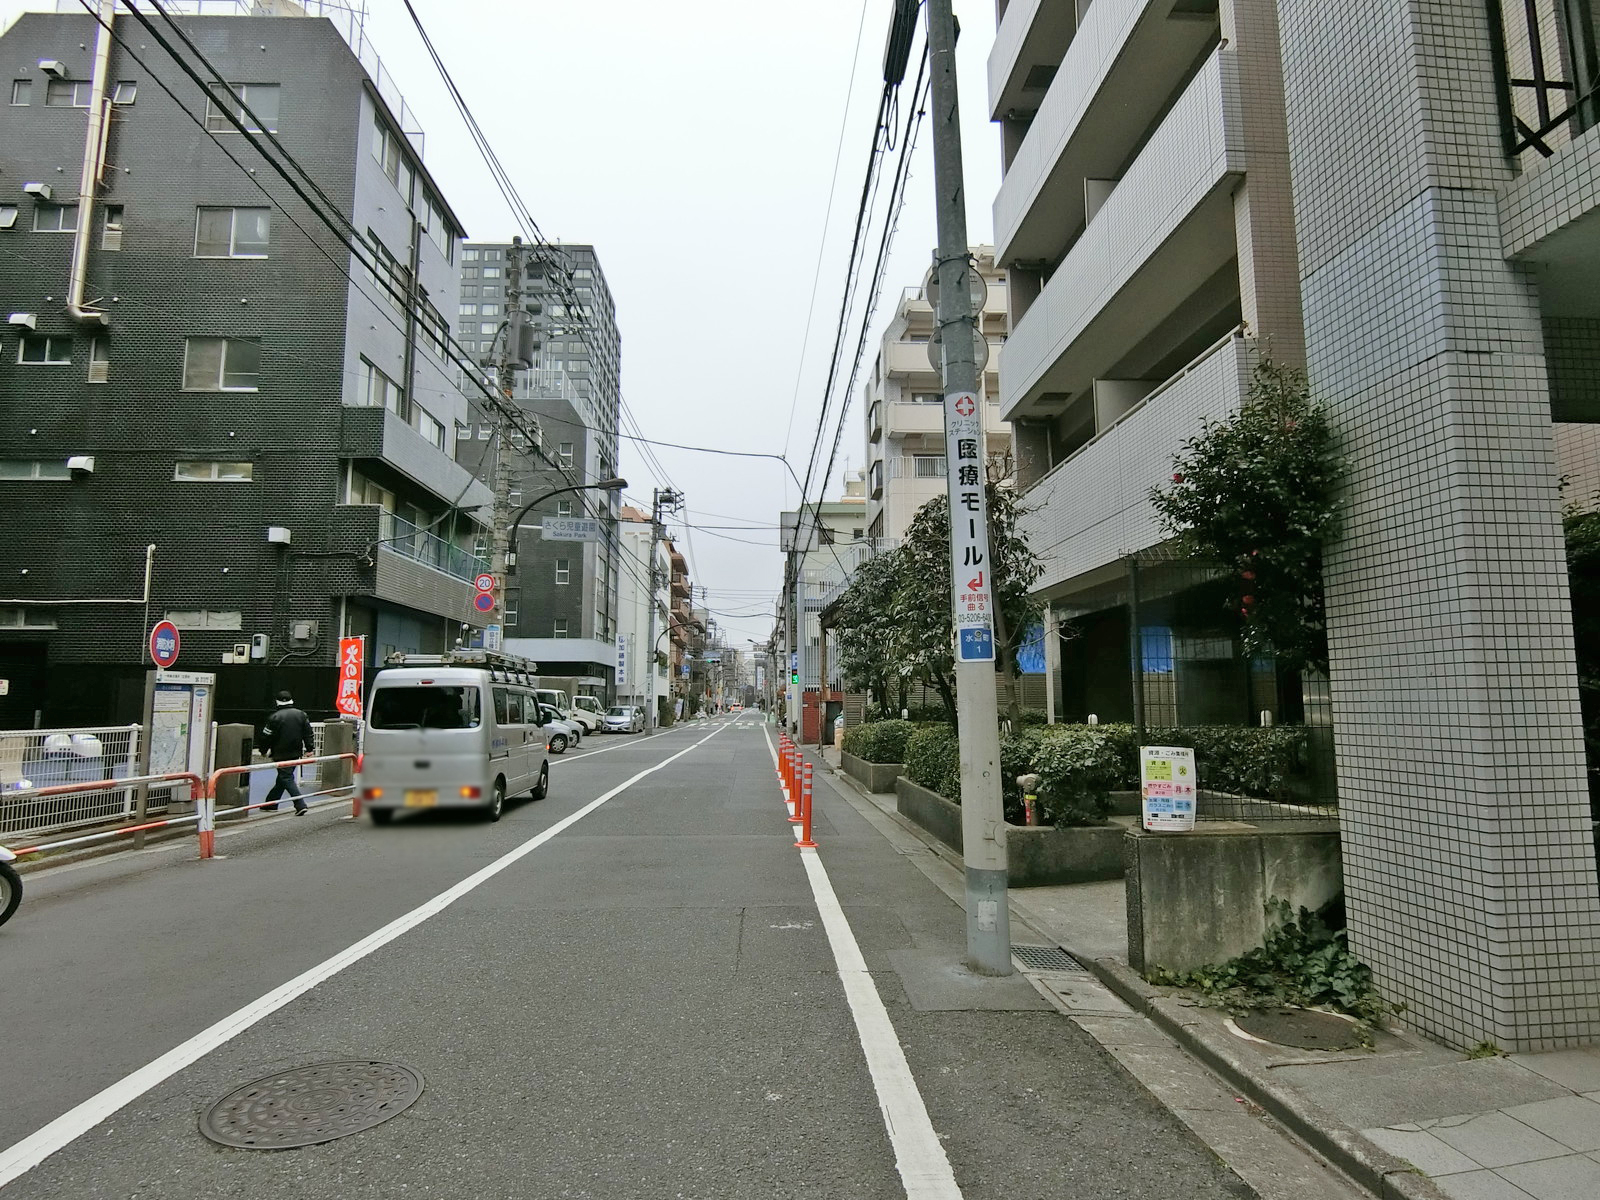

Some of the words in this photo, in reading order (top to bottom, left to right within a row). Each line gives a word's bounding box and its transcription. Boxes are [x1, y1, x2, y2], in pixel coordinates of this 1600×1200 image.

[958, 438, 983, 567] 医療モール
[545, 520, 596, 532] さくら児童遊園
[480, 579, 491, 588] 20
[960, 593, 990, 602] 手前信号
[967, 602, 985, 611] 曲る
[340, 644, 359, 713] 火の用心
[1179, 767, 1187, 775] 火
[1175, 785, 1182, 793] 月
